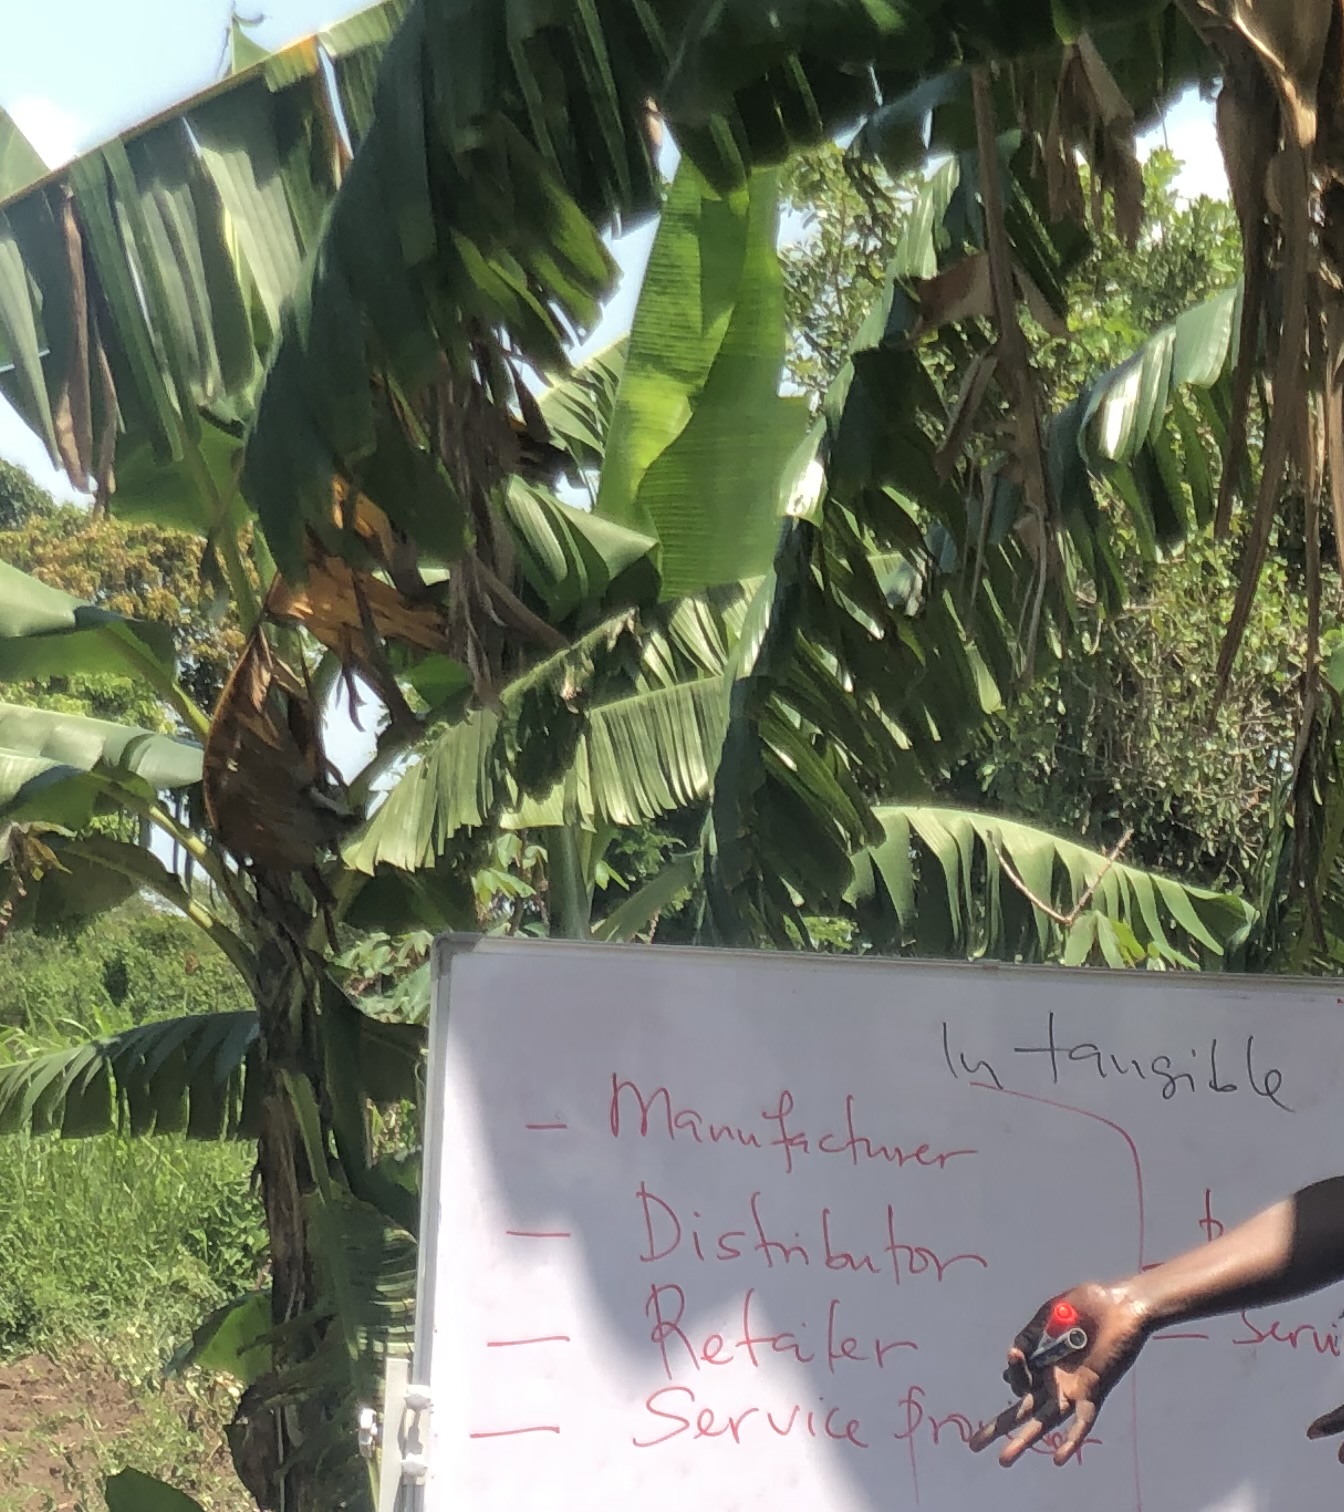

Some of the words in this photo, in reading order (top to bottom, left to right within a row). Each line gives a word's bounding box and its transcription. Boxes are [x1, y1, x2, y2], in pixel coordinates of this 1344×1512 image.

[636, 1180, 988, 1286] Distributor
[645, 1283, 919, 1380] Retailer
[632, 1385, 869, 1449] Service
